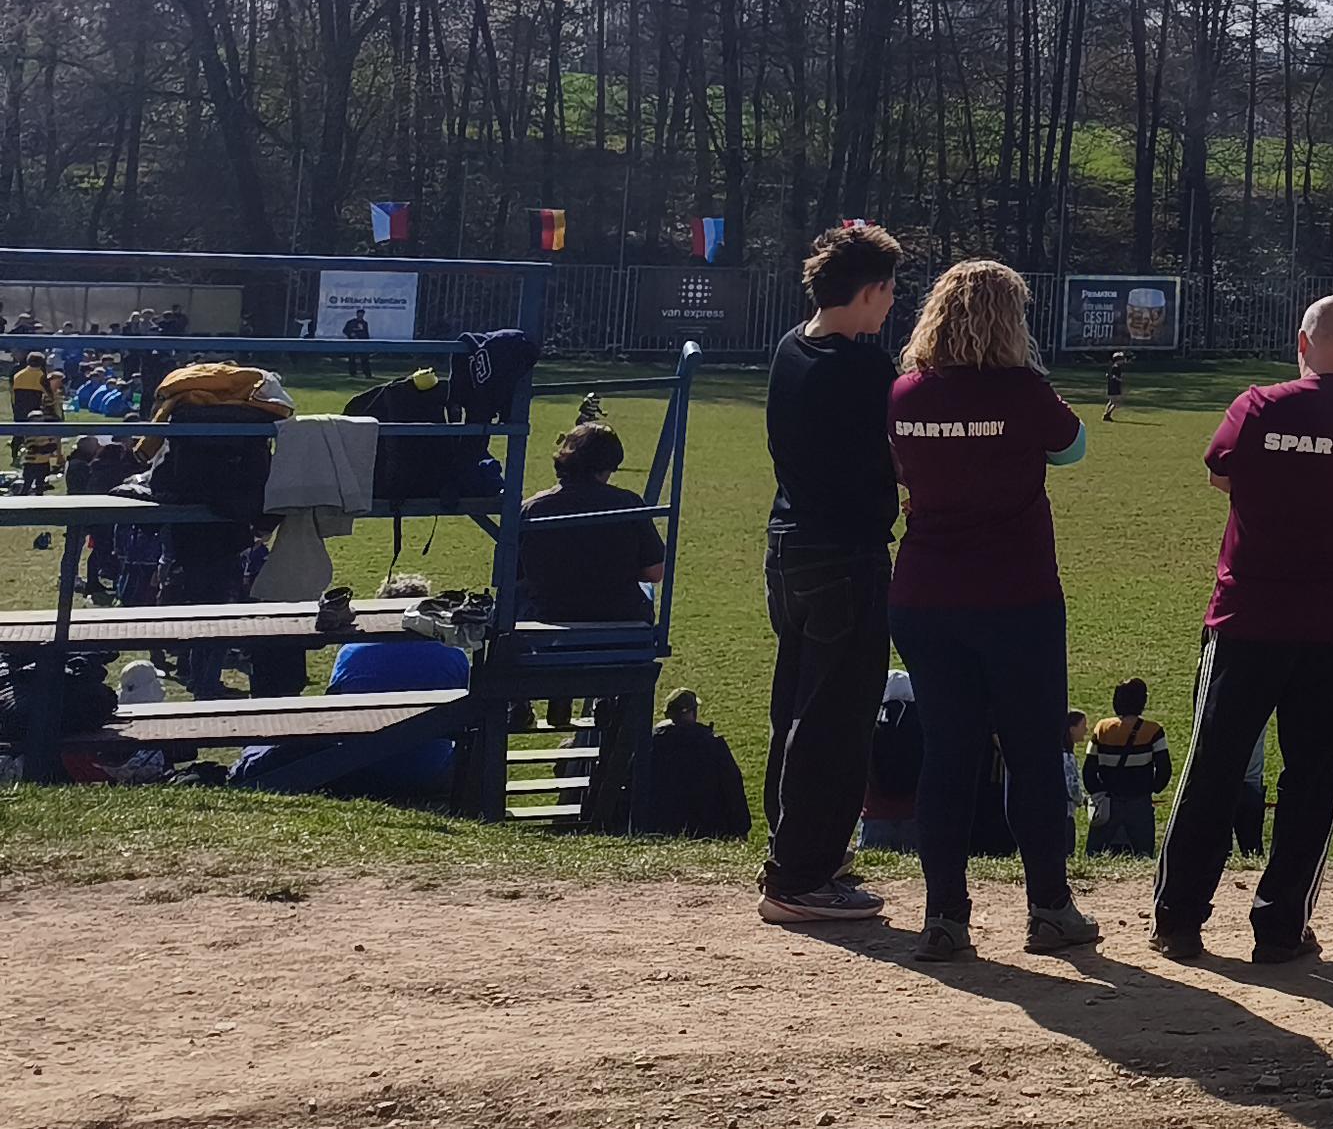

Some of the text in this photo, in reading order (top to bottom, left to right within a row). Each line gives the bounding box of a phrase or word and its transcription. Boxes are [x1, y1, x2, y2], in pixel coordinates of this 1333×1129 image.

[661, 309, 724, 319] van express
[895, 420, 1005, 438] SPARTA RUGBY
